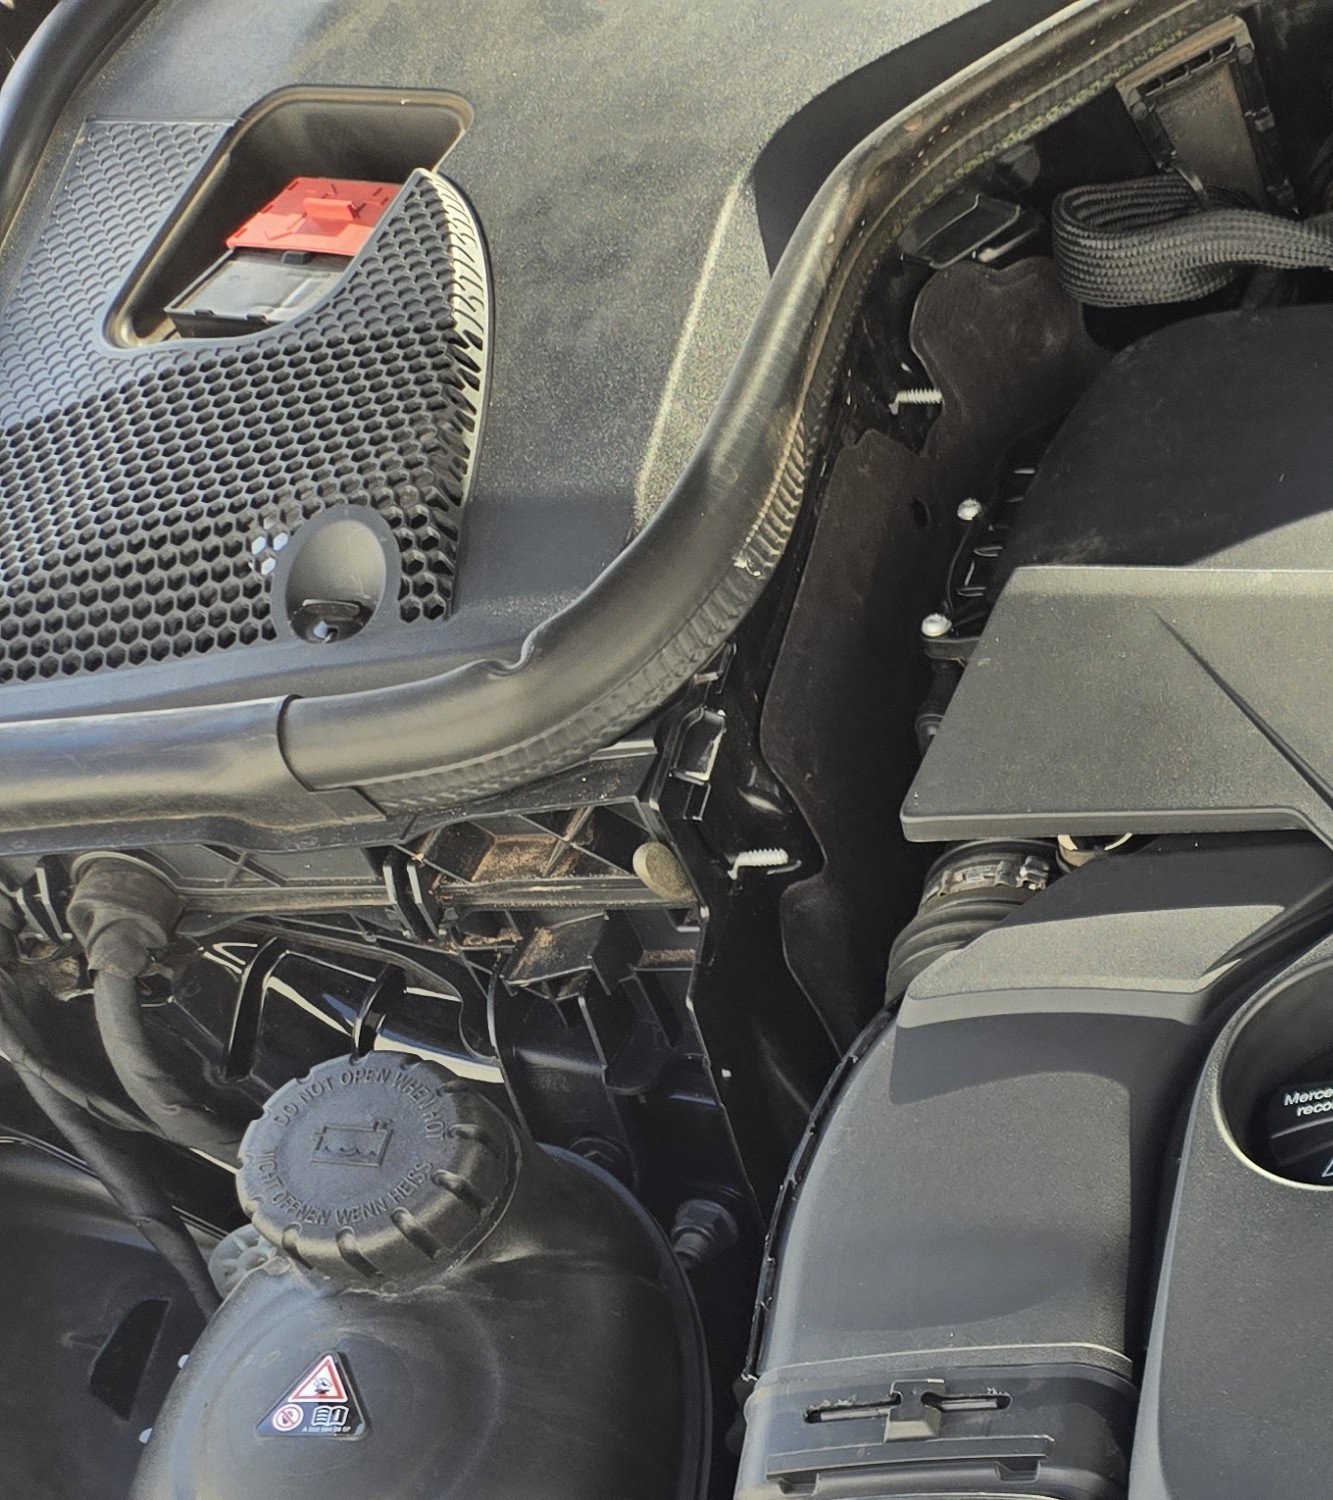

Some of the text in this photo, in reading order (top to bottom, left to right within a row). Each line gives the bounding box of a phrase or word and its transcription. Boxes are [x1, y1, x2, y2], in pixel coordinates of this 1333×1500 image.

[274, 1068, 447, 1141] DO NOT OPEN WHEN HOT
[336, 1197, 389, 1226] WENN
[388, 1161, 434, 1204] HEISS
